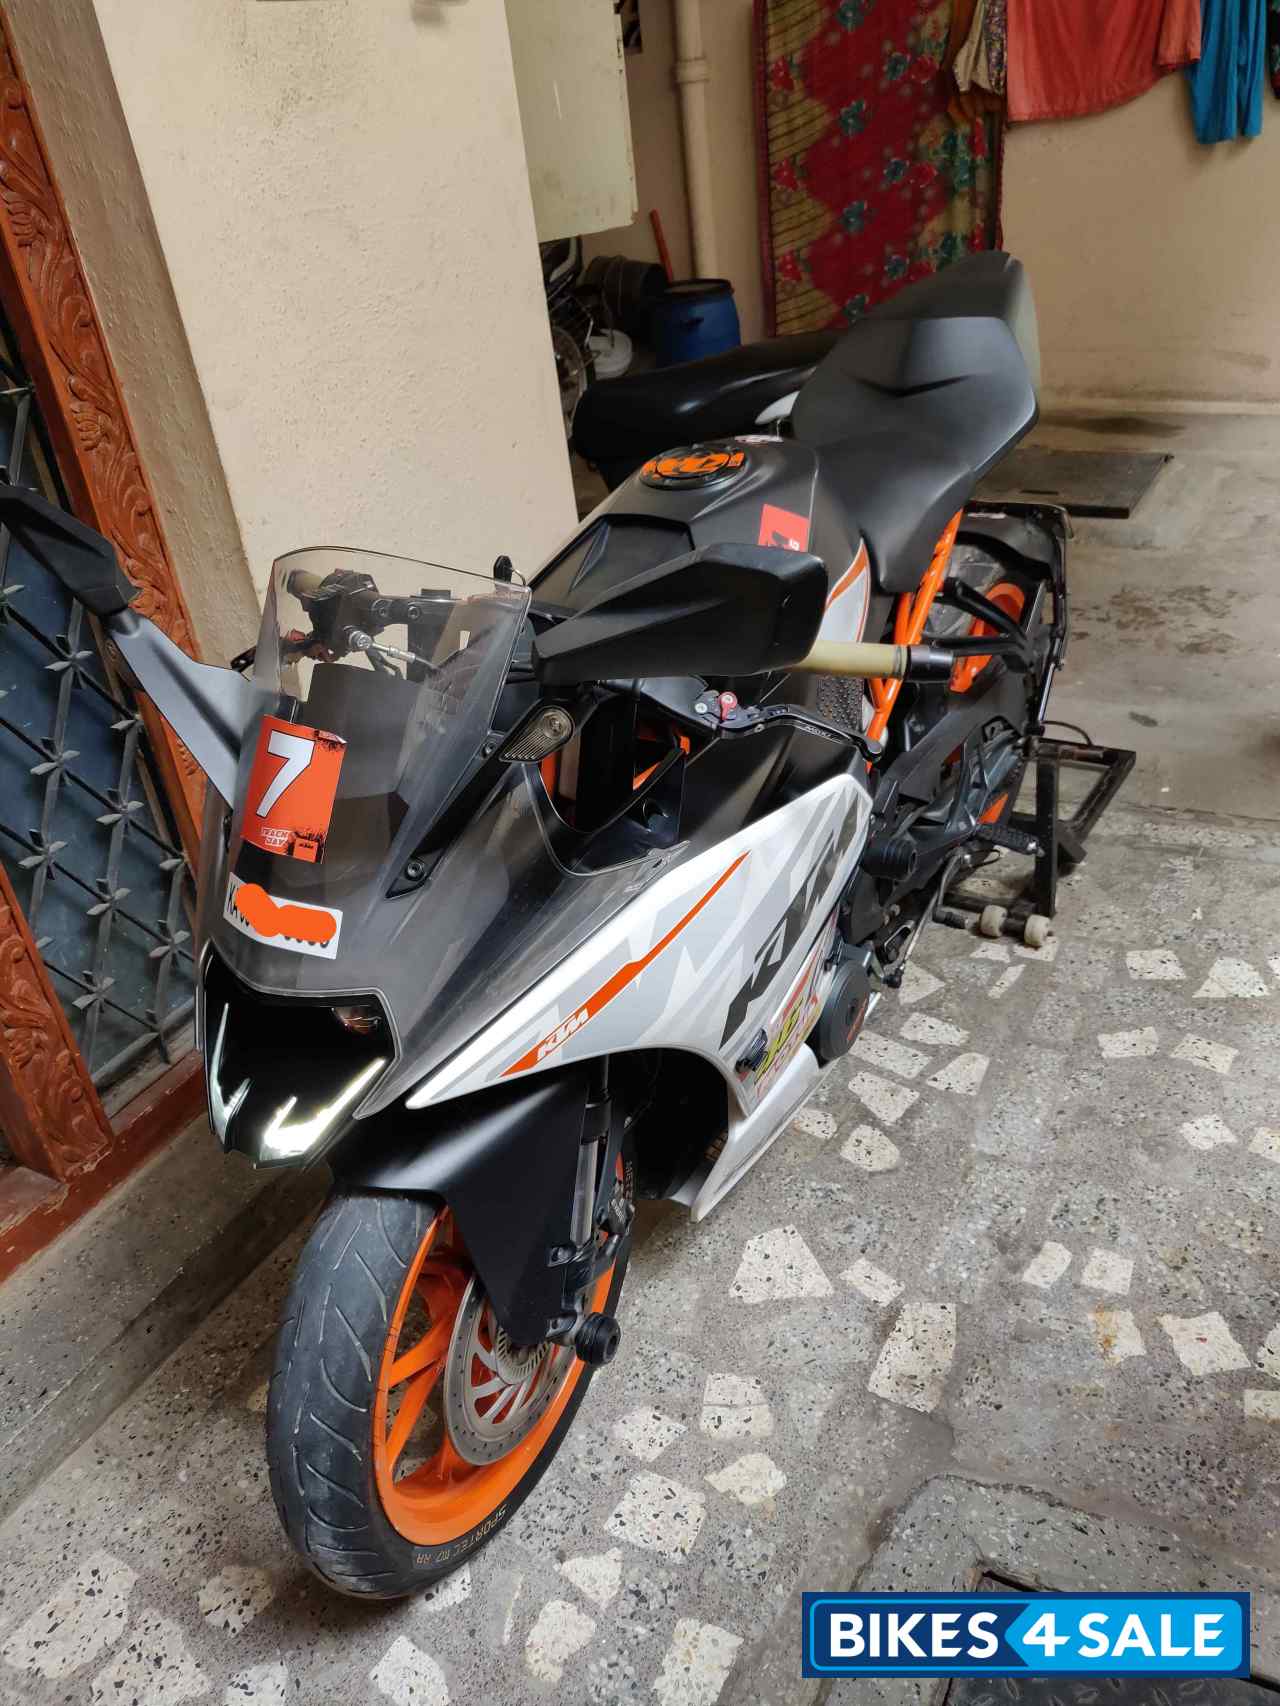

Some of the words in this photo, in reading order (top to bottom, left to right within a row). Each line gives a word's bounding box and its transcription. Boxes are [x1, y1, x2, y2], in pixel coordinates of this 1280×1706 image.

[256, 729, 316, 818] 7
[537, 1006, 589, 1061] KTM
[454, 1503, 508, 1557] SPORTEC
